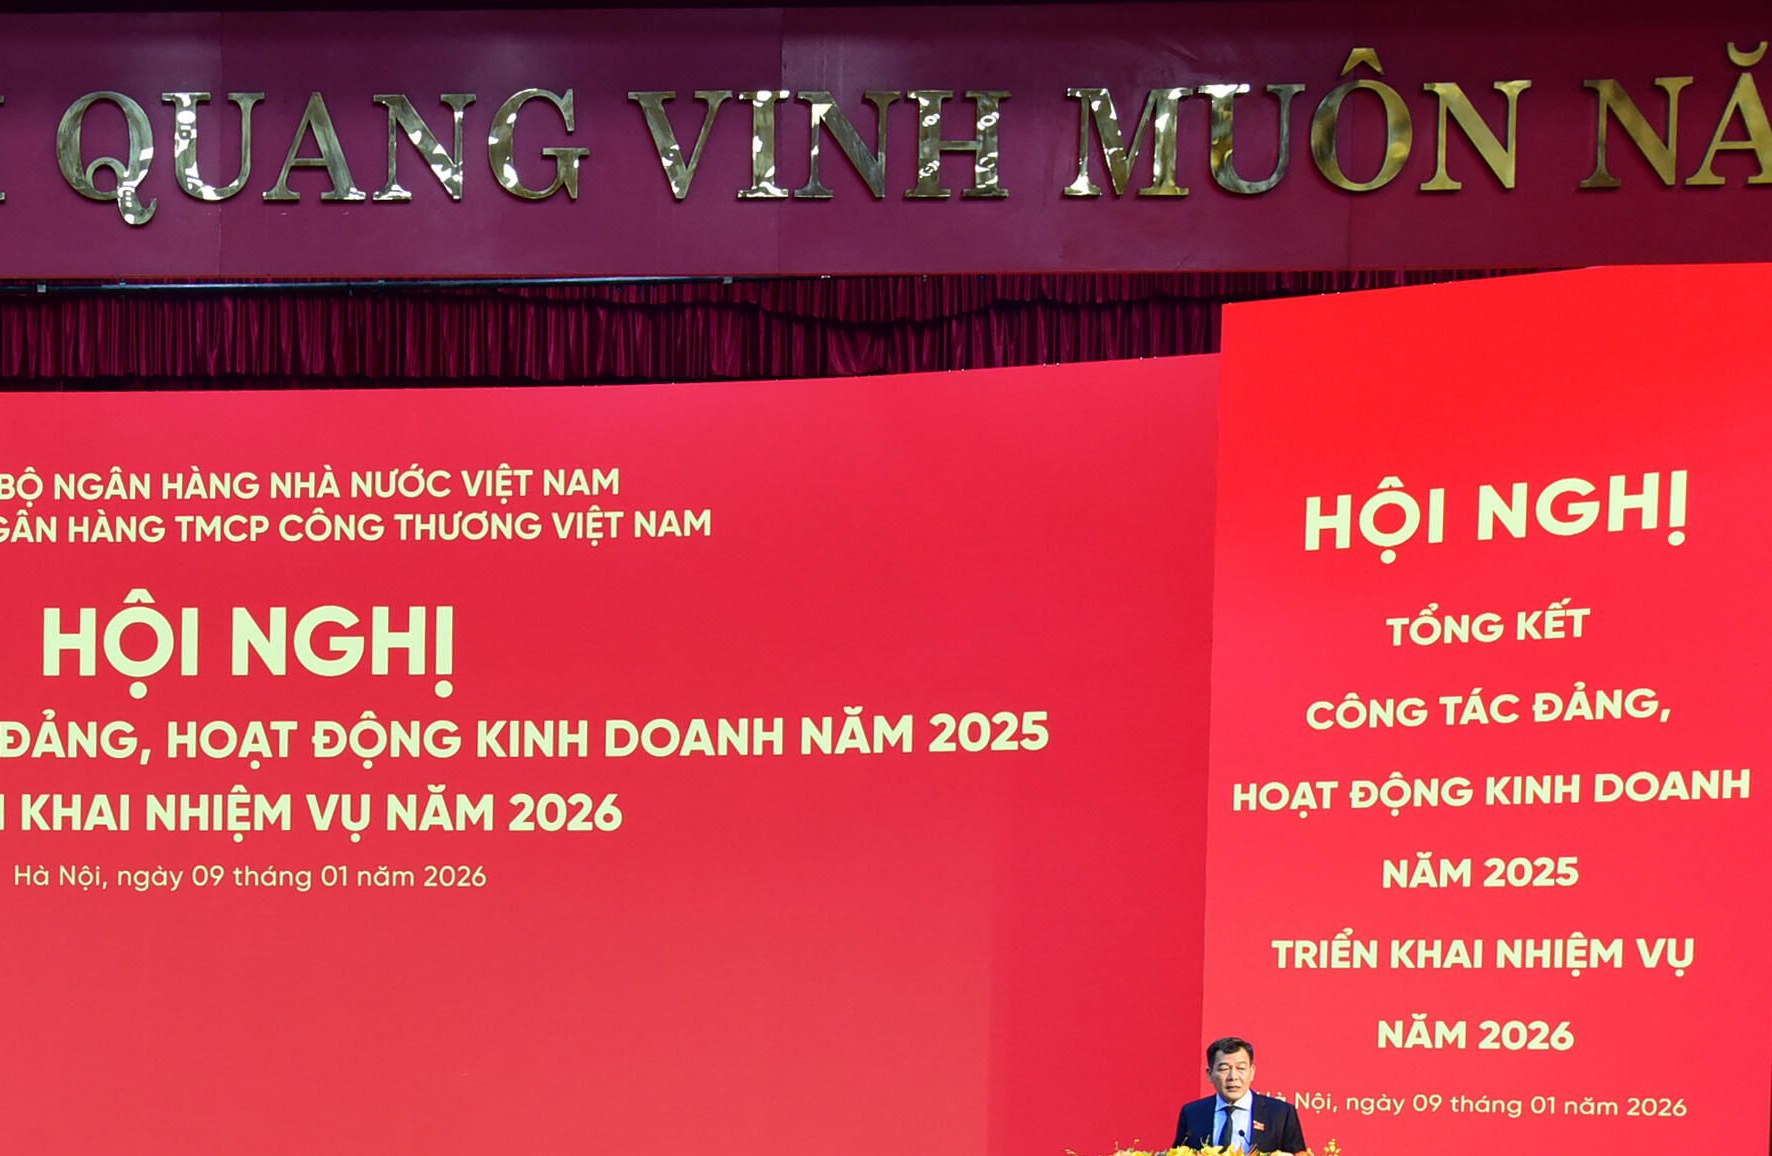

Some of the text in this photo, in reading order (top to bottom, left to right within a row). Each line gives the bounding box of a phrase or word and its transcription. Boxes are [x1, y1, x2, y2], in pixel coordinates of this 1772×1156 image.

[55, 87, 590, 227] QUANG
[627, 87, 1012, 201] VINH
[1065, 46, 1533, 198] MUÔN
[54, 465, 151, 501] NGÂN
[162, 465, 260, 500] HÀNG
[270, 464, 341, 499] NHÀ
[351, 463, 452, 498] NƯỚC
[460, 462, 534, 505] VIỆT
[543, 467, 619, 496] NAM
[68, 508, 166, 543] HÀNG
[174, 514, 270, 543] TMCP
[278, 507, 385, 542] CÔNG
[393, 510, 542, 541] THƯƠNG
[551, 504, 625, 547] VIỆT
[634, 509, 711, 538] NAM
[1304, 469, 1688, 565] HỘI NGHỊ
[43, 588, 454, 700] HỘI NGHỊ
[1385, 597, 1591, 647] TỔNG KẾT
[1306, 681, 1671, 730] CÔNG TÁC ĐẢNG,
[167, 720, 298, 770] HOẠT
[311, 710, 462, 770] ĐỘNG
[477, 719, 589, 758] KINH
[605, 717, 784, 758] DOANH
[801, 705, 913, 755] NĂM
[928, 711, 1049, 753] 2025
[21, 793, 130, 831] KHAI
[146, 784, 292, 843] NHIỆM
[305, 793, 371, 843] VỤ
[386, 784, 494, 831] NĂM
[508, 792, 623, 832] 2026
[1233, 768, 1751, 819] HOẠT ĐỘNG KINH DOANH
[14, 864, 487, 892] Hà Nội, ngày 09 tháng 01 năm 2026
[1382, 851, 1580, 889] NĂM 2025
[1271, 927, 1695, 978] TRIỂN KHAI NHIỆM VỤ
[1377, 1012, 1575, 1051] NĂM 2026
[1294, 1091, 1338, 1114] Nội,
[1346, 1093, 1405, 1116] ngày
[1412, 1093, 1443, 1112] 09
[1449, 1094, 1523, 1119] tháng
[1530, 1095, 1556, 1115] 01
[1564, 1097, 1619, 1116] năm
[1626, 1097, 1688, 1117] 2026
